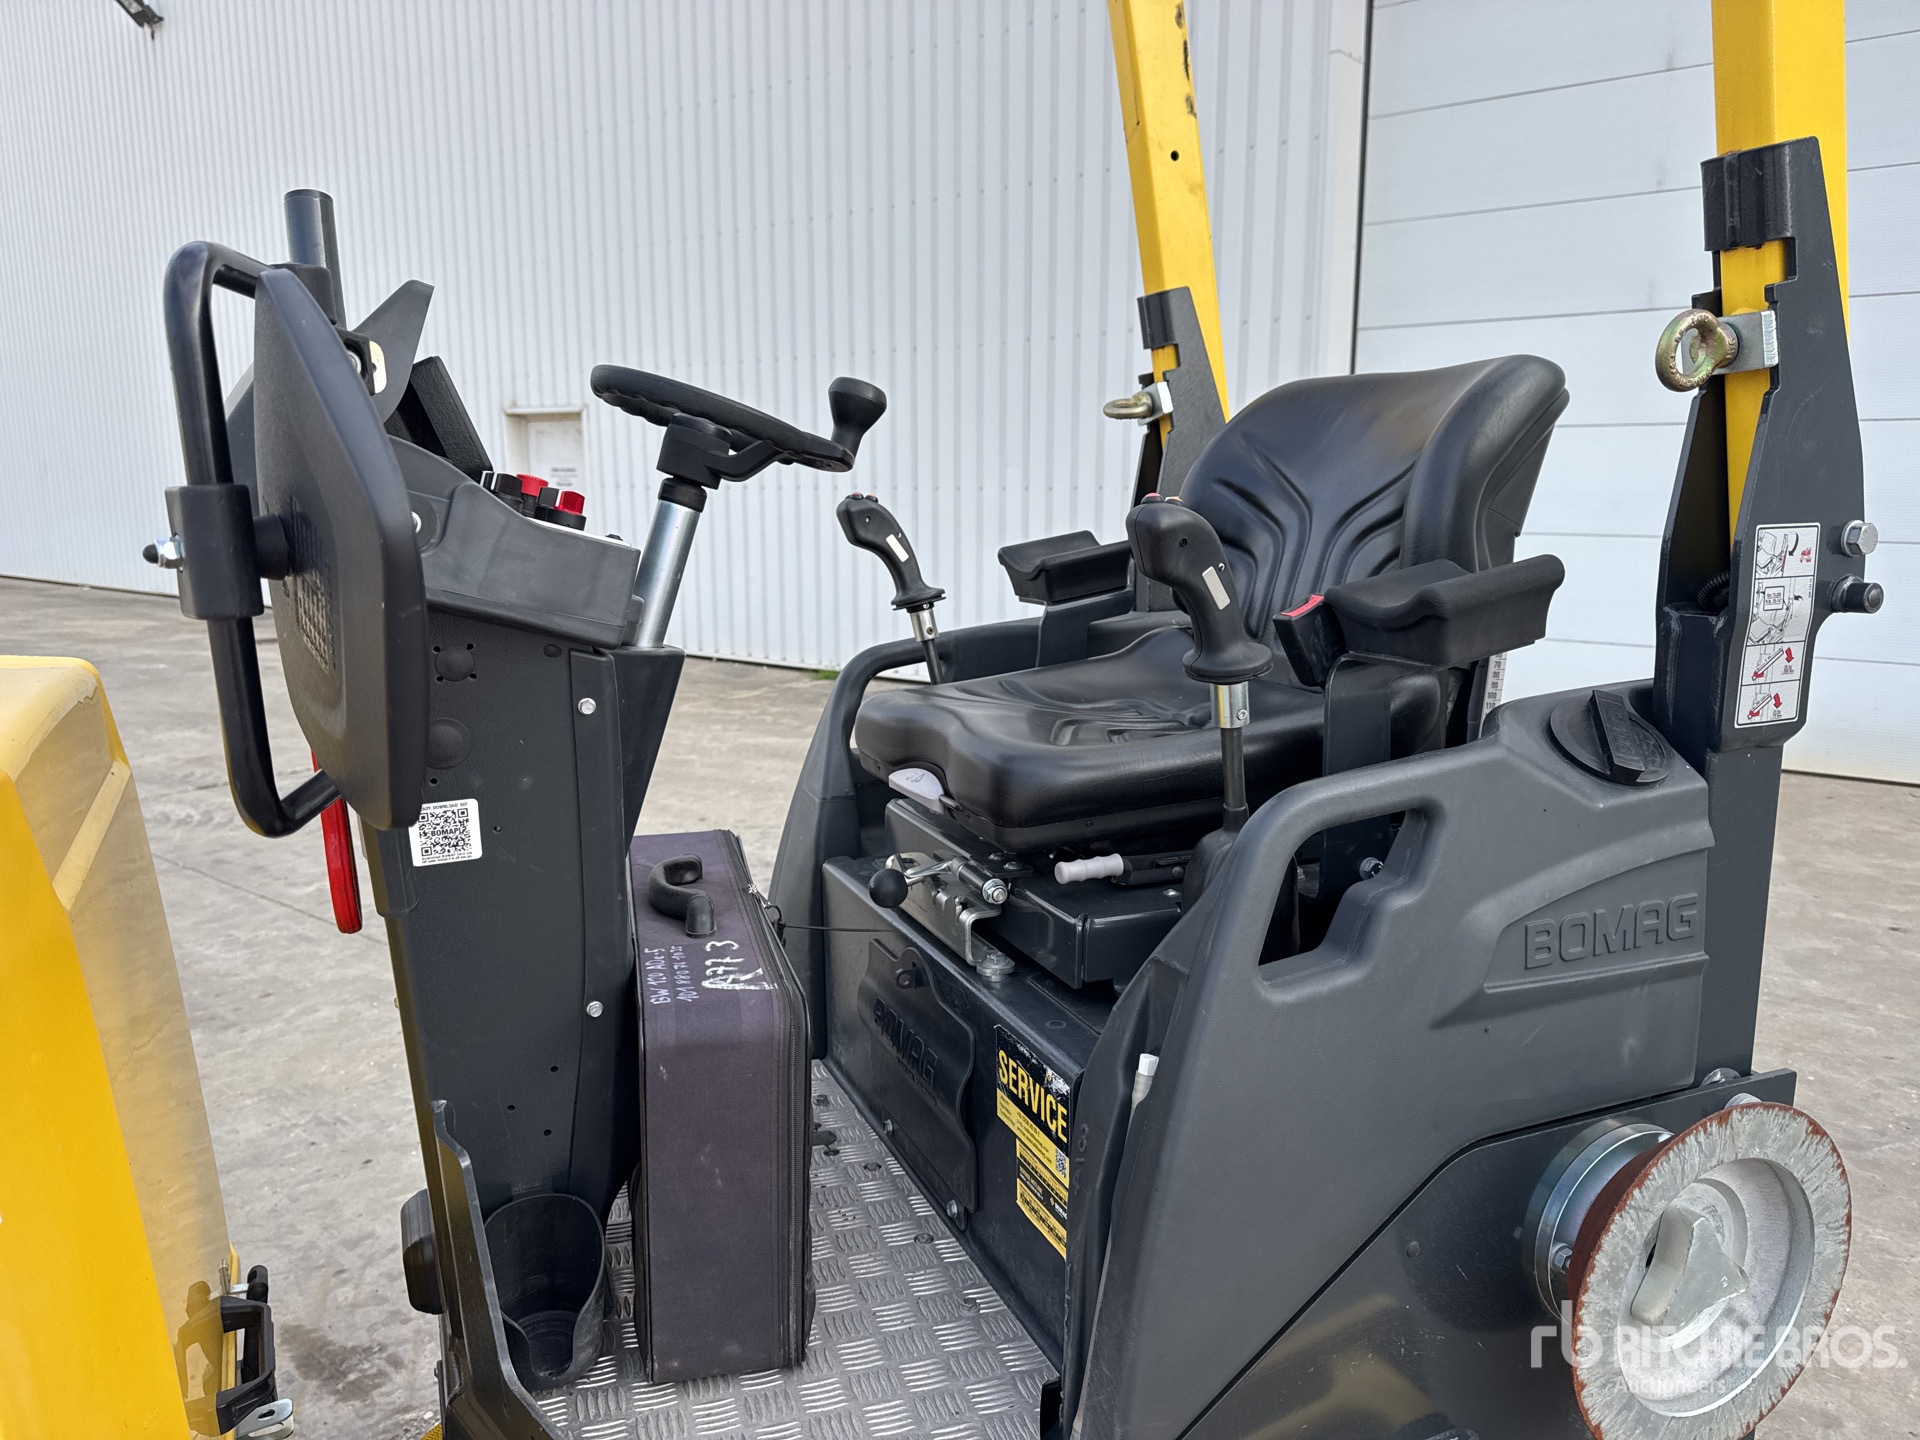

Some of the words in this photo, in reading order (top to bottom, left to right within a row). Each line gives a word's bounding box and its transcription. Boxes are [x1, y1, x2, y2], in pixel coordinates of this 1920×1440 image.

[1524, 893, 1698, 970] BOMAG
[646, 972, 666, 985] 120
[650, 987, 671, 1005] BW
[874, 996, 938, 1092] BOMAG
[998, 1049, 1068, 1144] SERVICE
